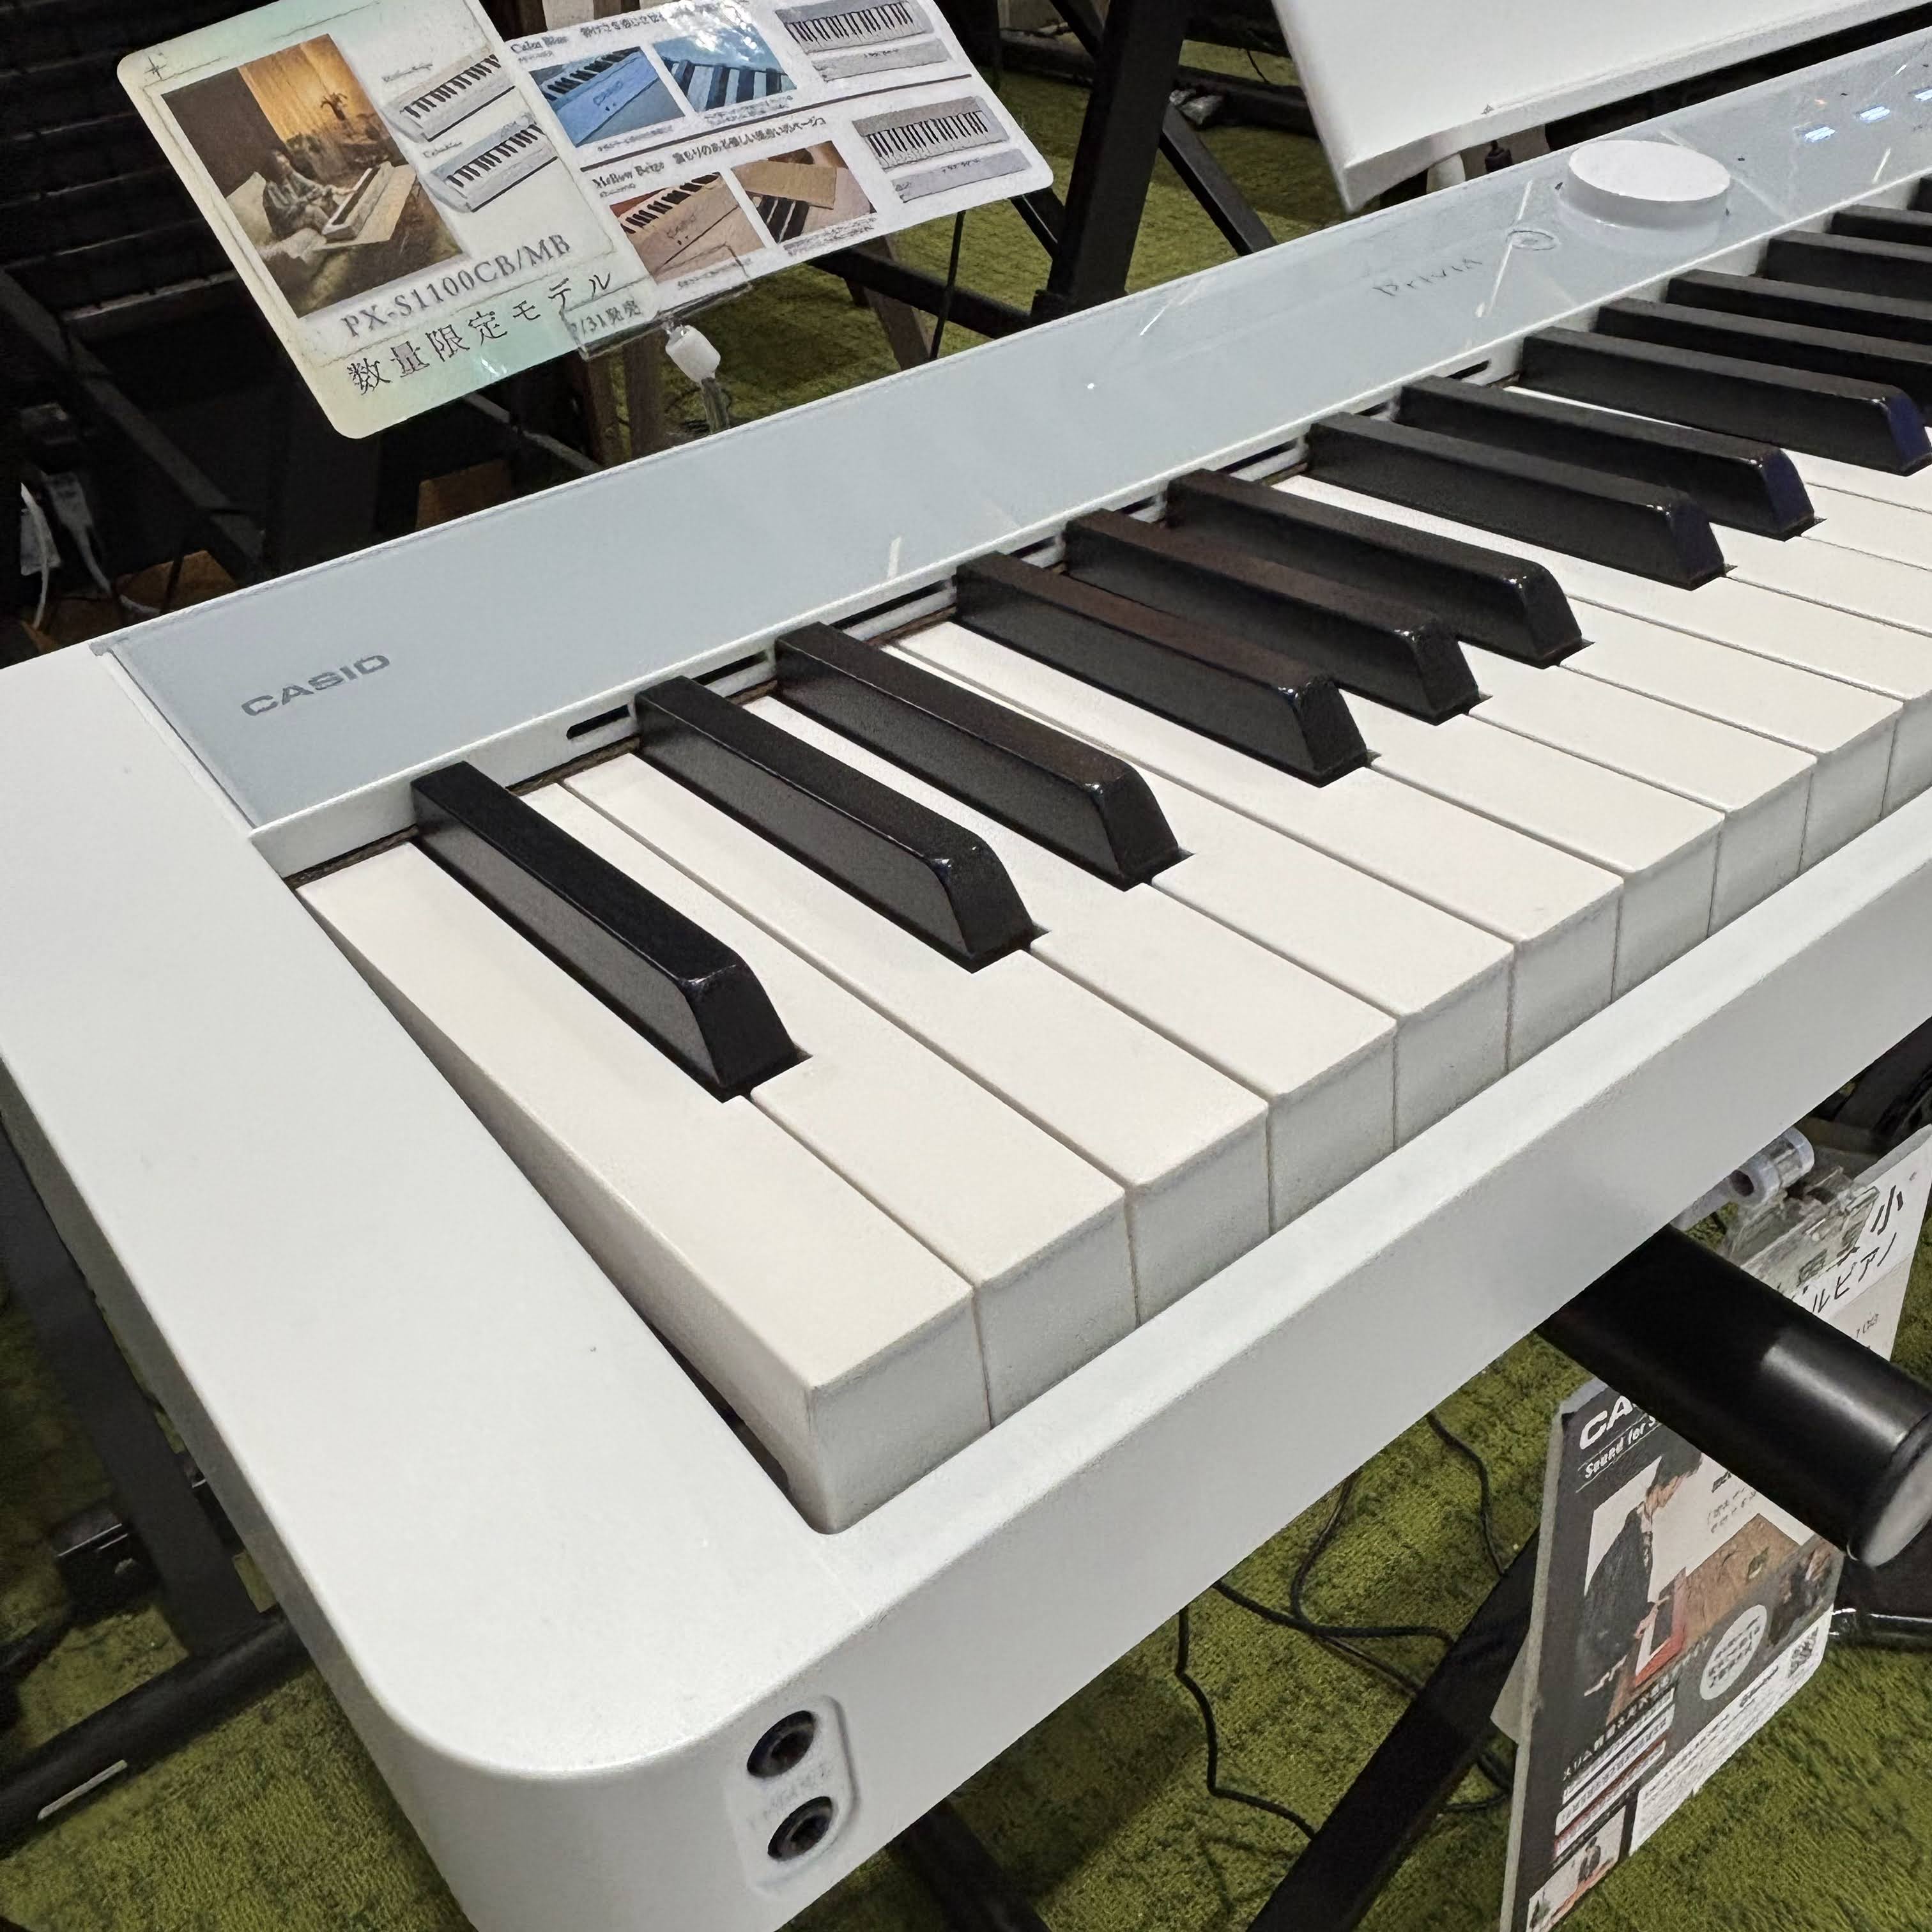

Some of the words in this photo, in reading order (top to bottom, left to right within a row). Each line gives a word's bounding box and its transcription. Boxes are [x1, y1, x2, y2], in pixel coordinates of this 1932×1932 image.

[344, 234, 571, 337] PX-S1100CB/MB
[347, 272, 611, 395] 数量限定モデル
[241, 655, 390, 716] CASIO
[1802, 1232, 1897, 1314] ルピアノ
[1579, 1395, 1637, 1450] CA
[1584, 1436, 1625, 1479] Sound
[1628, 1422, 1646, 1445] for
